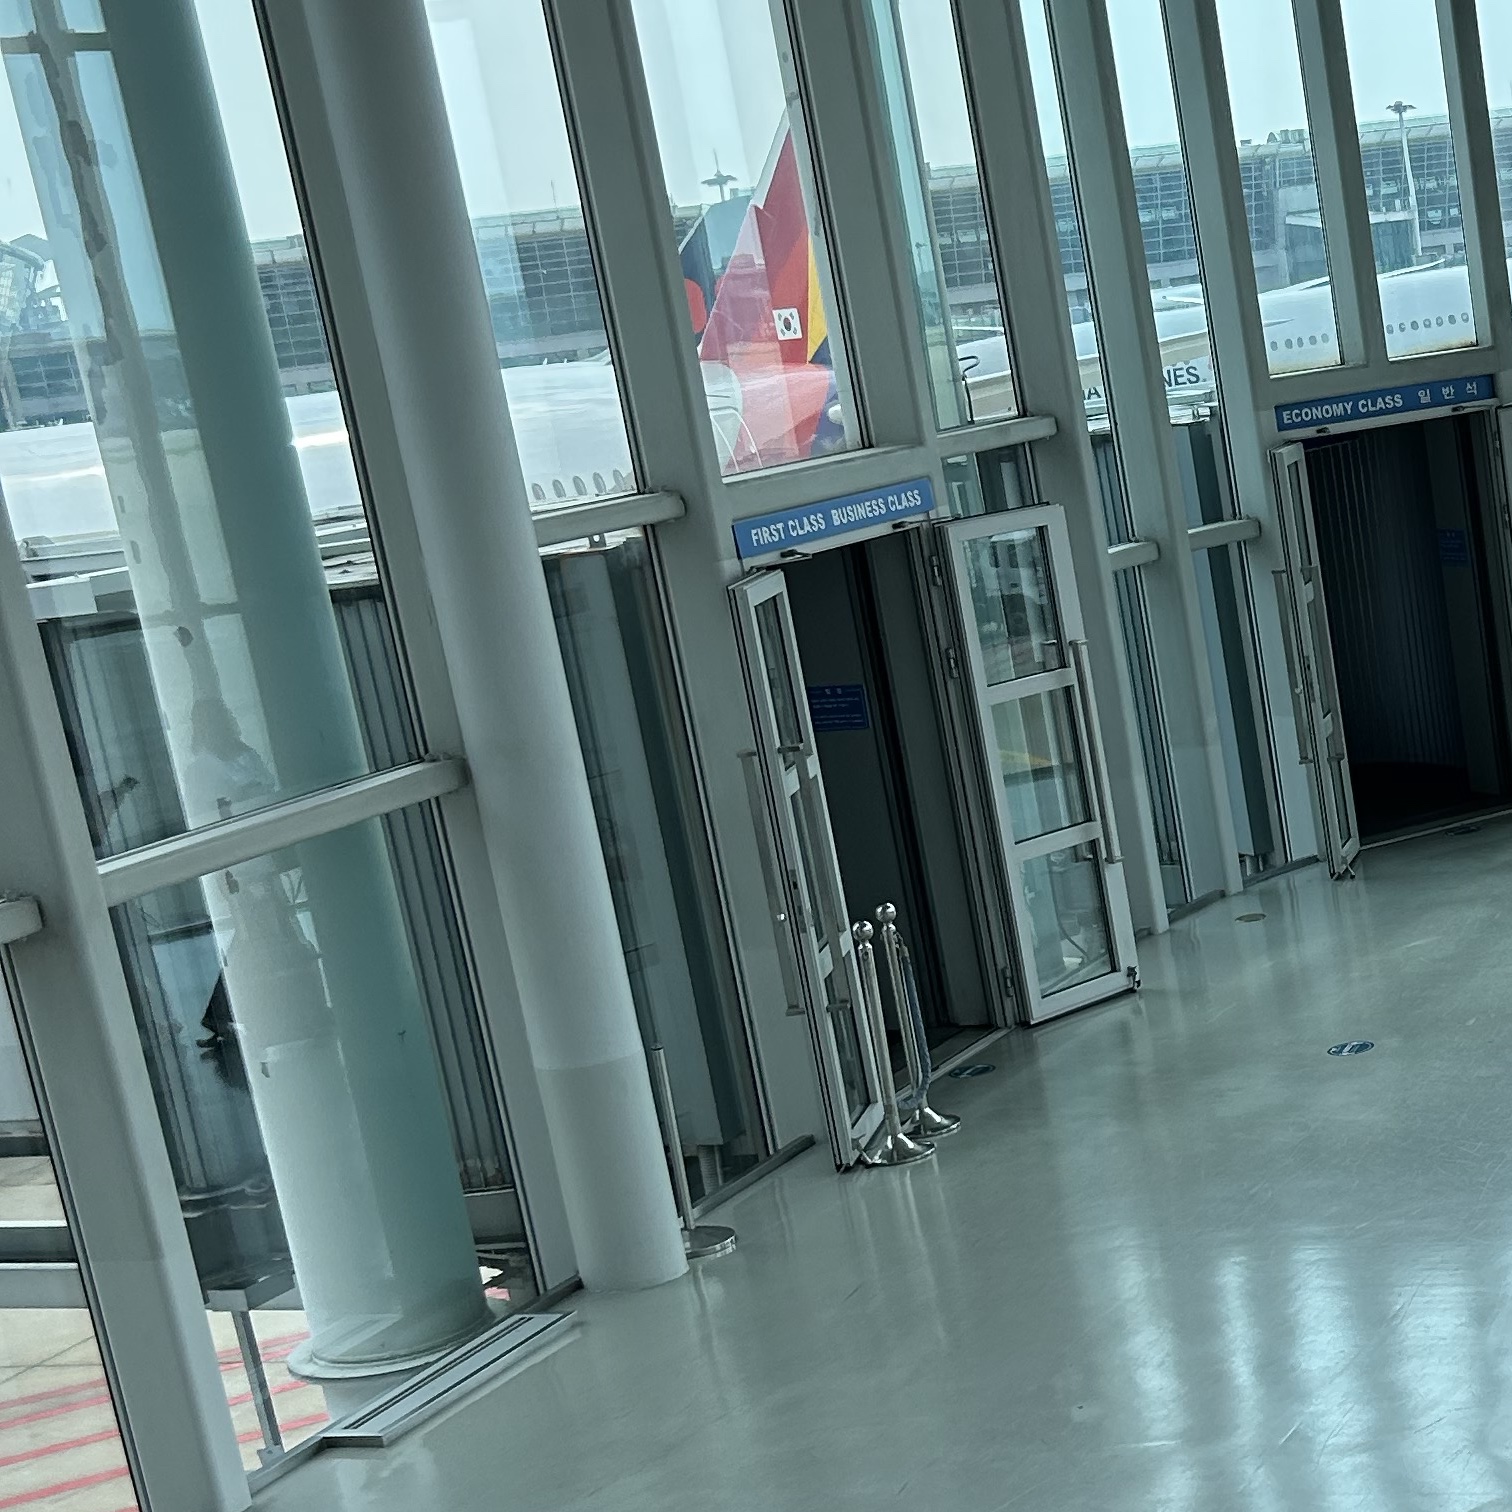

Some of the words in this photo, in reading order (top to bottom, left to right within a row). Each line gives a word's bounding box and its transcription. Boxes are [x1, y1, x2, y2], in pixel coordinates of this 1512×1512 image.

[1282, 400, 1352, 424] ECONOMY
[1358, 394, 1403, 413] CLASS
[751, 522, 785, 547] FIRST
[788, 513, 826, 537] CLASS
[830, 497, 886, 526] BUSINESS
[887, 489, 922, 512] CLASS
